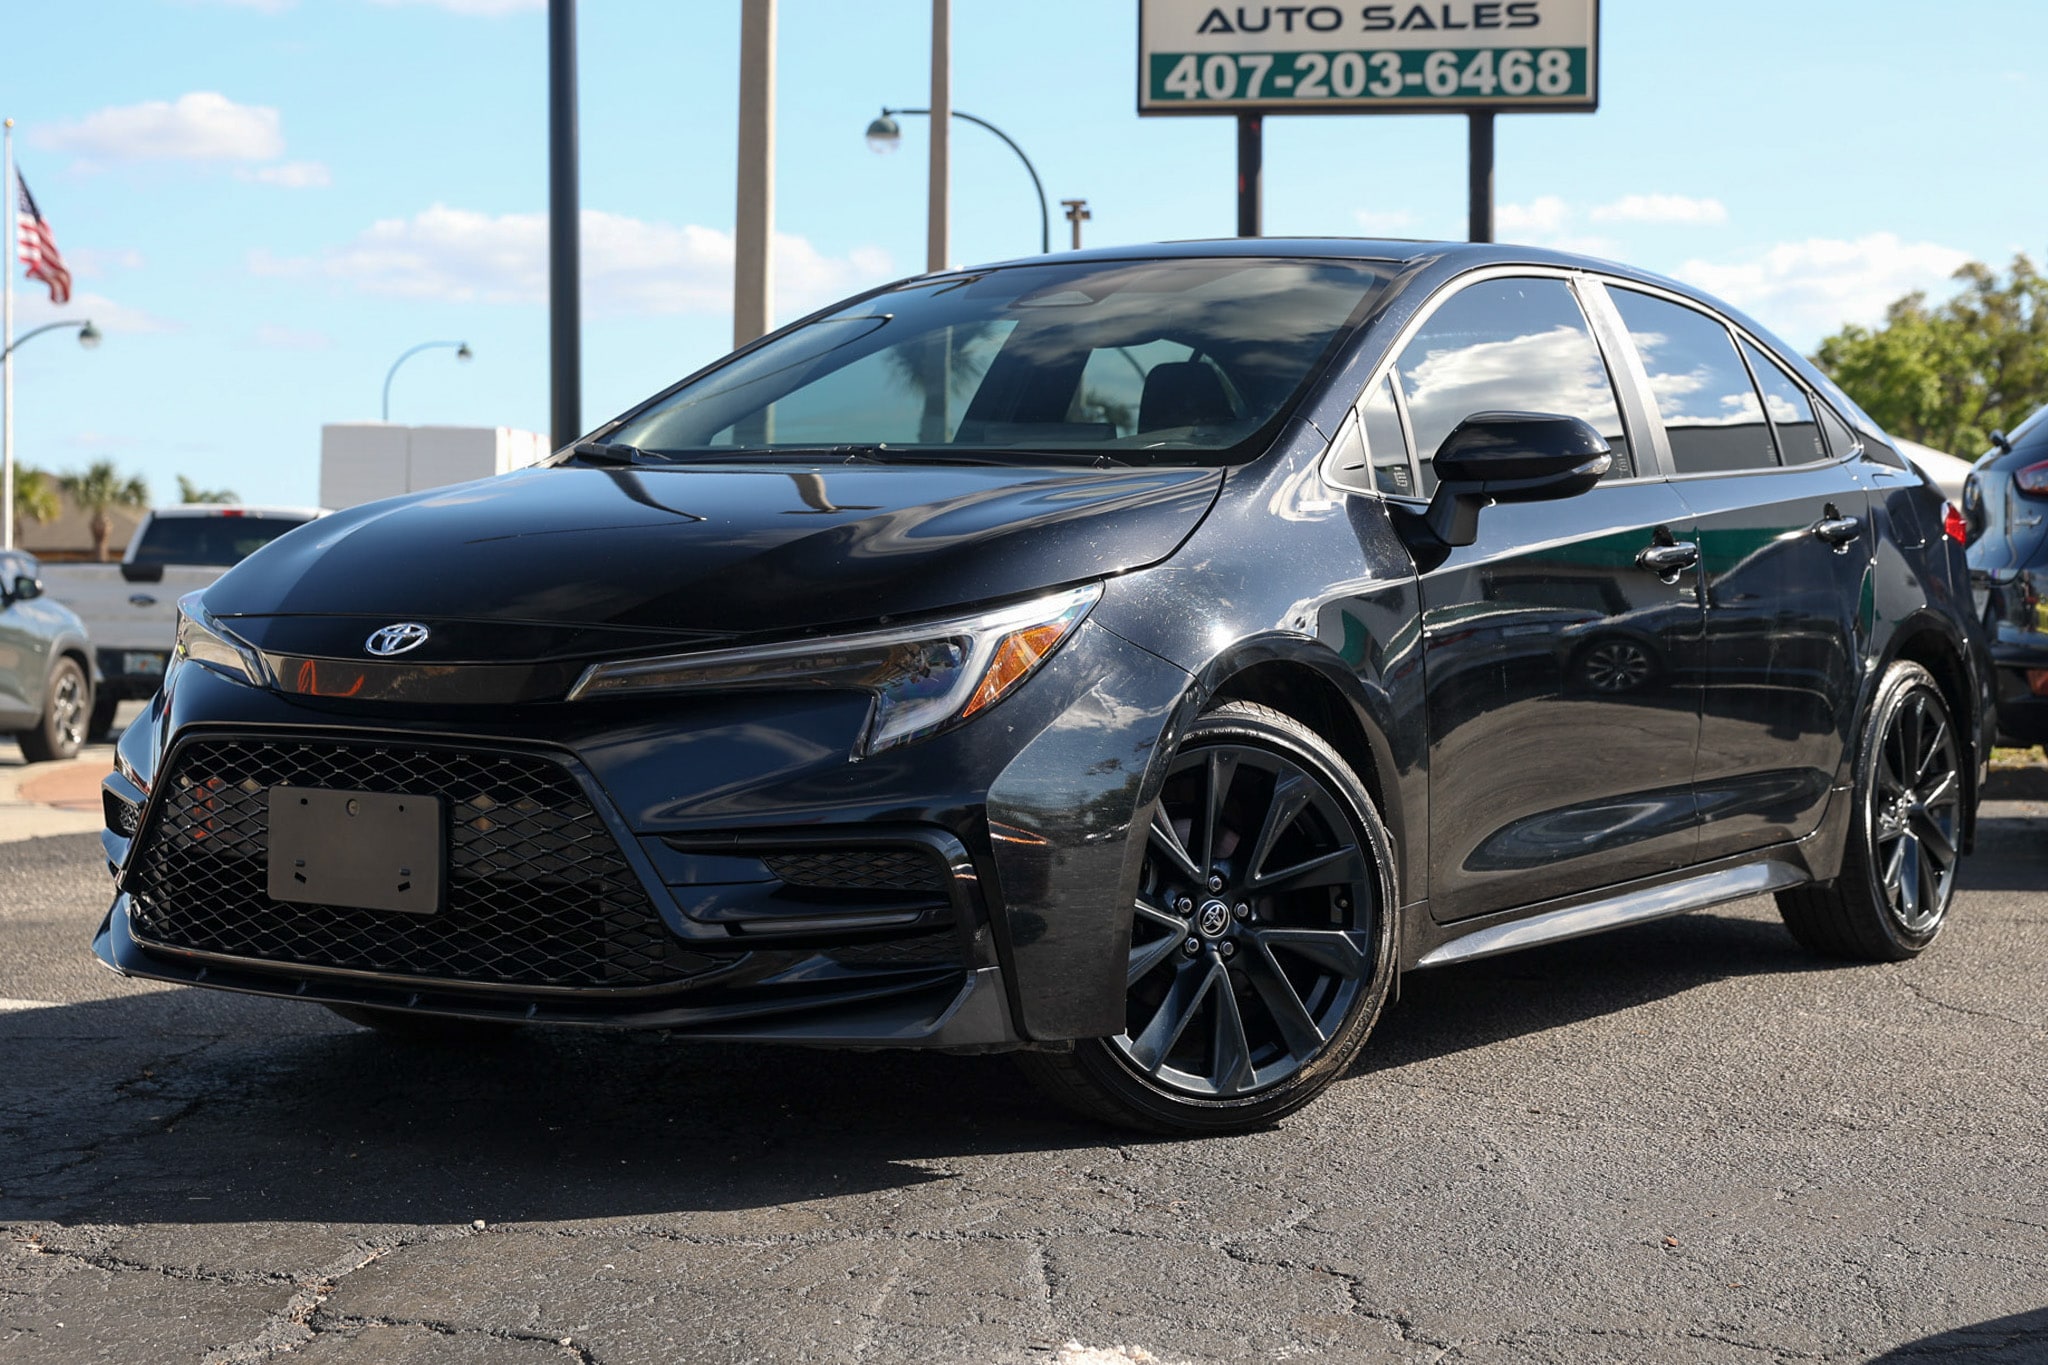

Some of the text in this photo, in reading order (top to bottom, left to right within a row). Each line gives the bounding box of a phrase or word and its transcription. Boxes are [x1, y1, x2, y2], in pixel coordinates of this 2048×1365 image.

[1197, 2, 1541, 34] AUTO SALES
[1164, 49, 1571, 99] 407-203-6468
